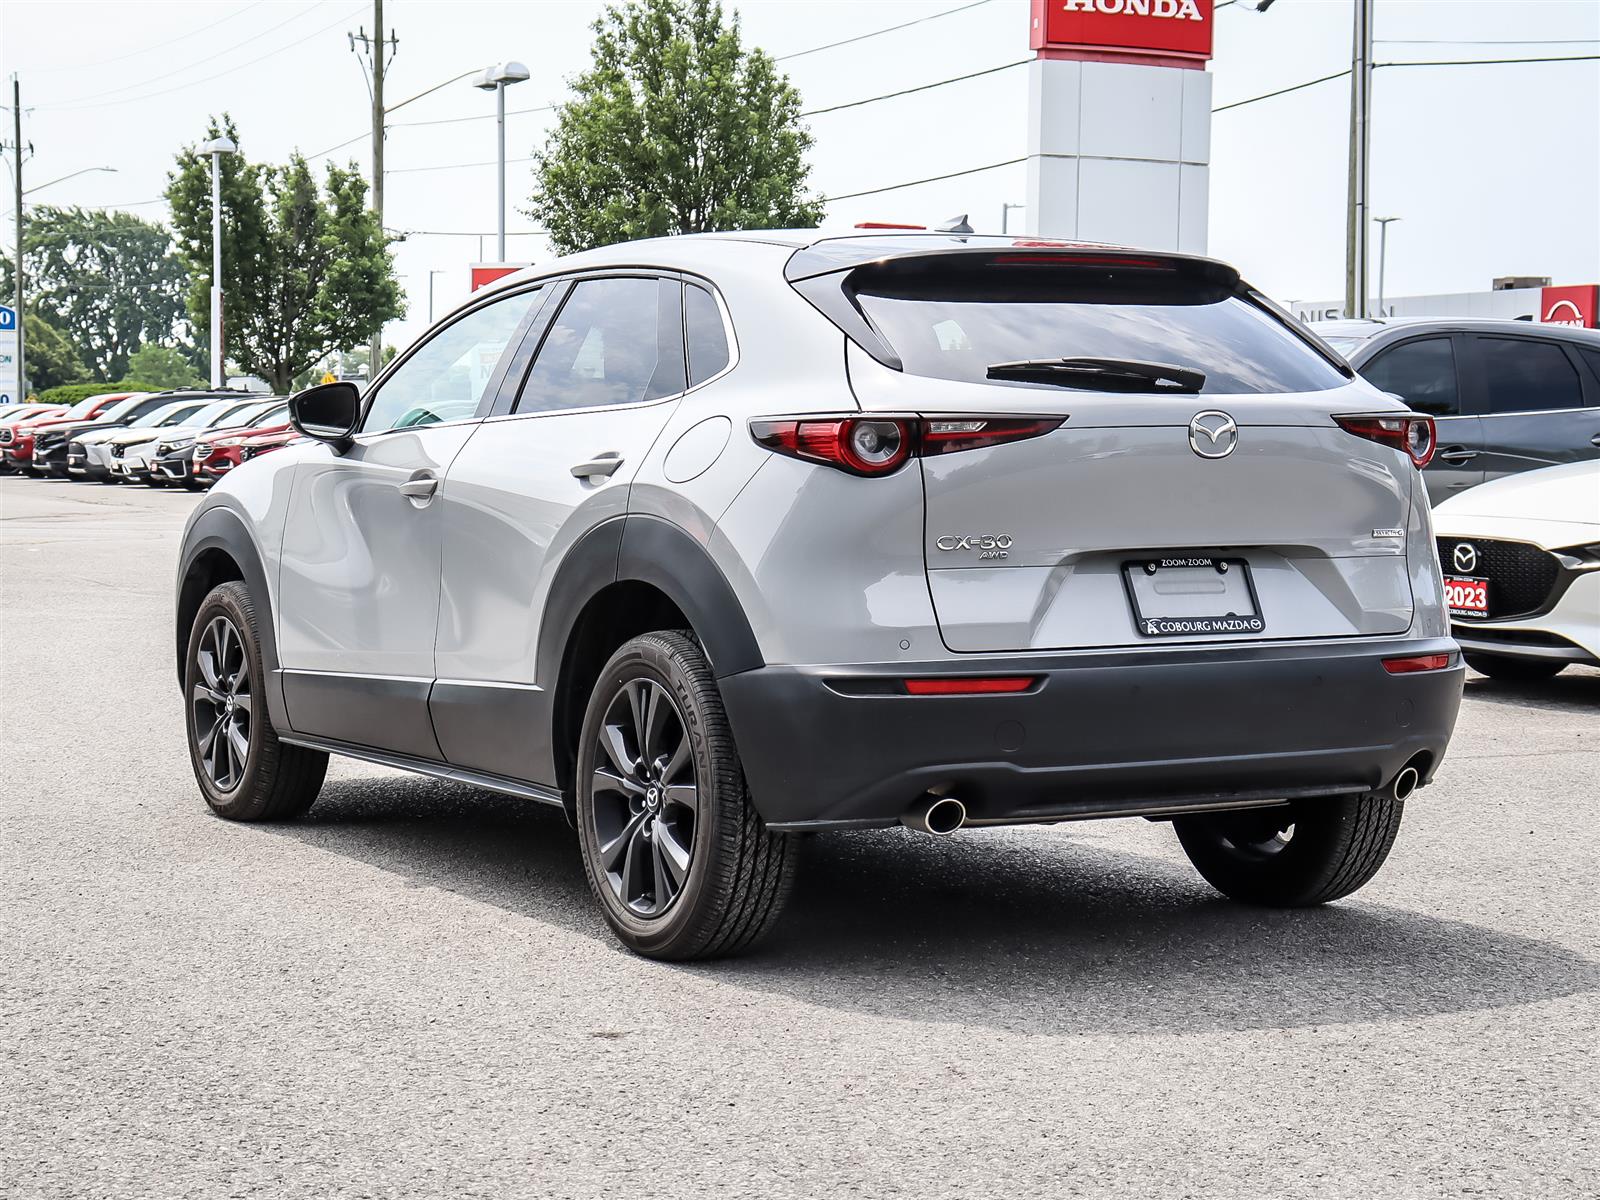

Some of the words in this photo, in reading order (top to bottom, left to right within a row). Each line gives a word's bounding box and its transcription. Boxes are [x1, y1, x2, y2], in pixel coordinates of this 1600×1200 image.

[1063, 0, 1203, 20] HONDA
[1300, 305, 1394, 322] NISN
[936, 534, 1012, 551] CX-30
[979, 551, 1009, 560] AWD
[1161, 558, 1213, 567] ZOOM-ZOOM
[1445, 585, 1487, 608] 2023
[1160, 621, 1211, 632] COBOURG
[1212, 620, 1251, 631] MAZDA
